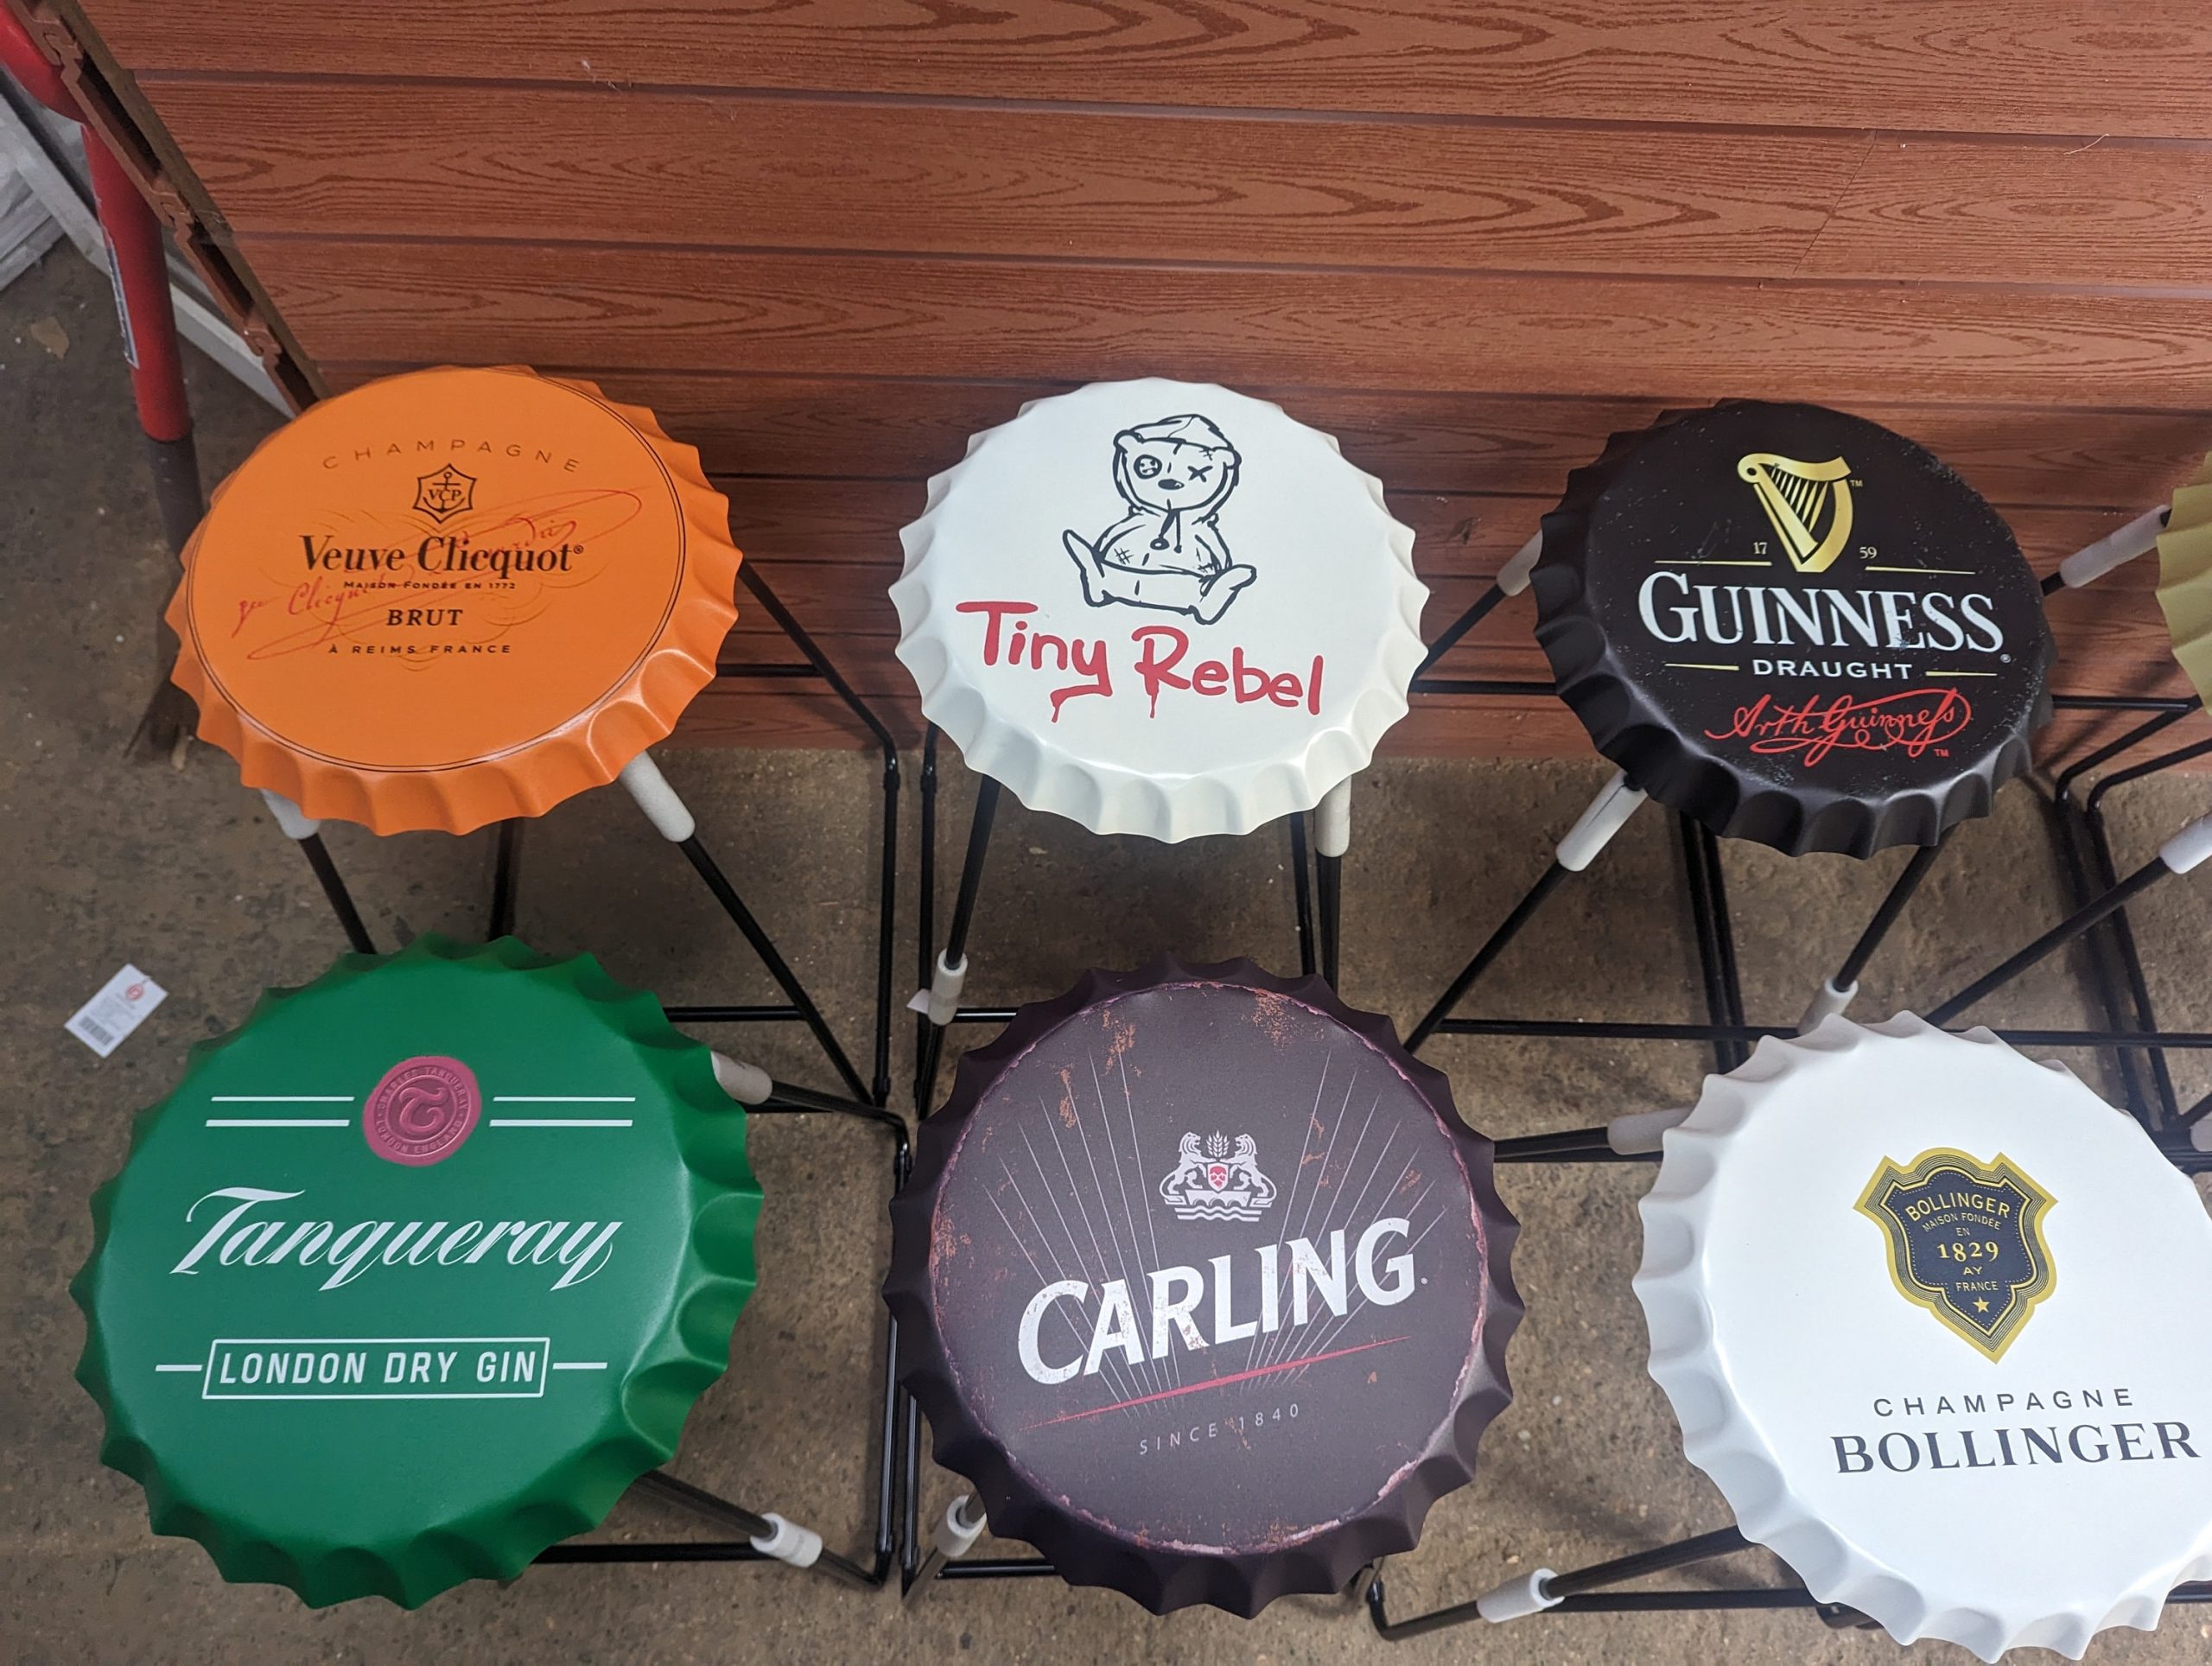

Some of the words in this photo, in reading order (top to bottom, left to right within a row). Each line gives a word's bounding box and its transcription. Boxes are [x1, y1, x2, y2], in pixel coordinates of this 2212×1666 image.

[322, 439, 580, 473] CHAMPAGNE
[428, 487, 462, 503] VCP
[299, 534, 405, 571] Veuve
[1753, 542, 1768, 555] 17
[1859, 546, 1878, 559] 59
[344, 581, 397, 589] MAISON
[386, 608, 464, 626] BRUT
[352, 645, 416, 654] REIMS
[429, 645, 511, 653] FRANCE
[956, 601, 1113, 722] Tiny
[1131, 626, 1324, 719] Rebel
[1752, 659, 1912, 680] DRAUGHT
[1904, 1192, 2011, 1222] BOLLINGER
[1922, 1212, 1959, 1232] MAISON
[1961, 1212, 2002, 1230] FONDÉE
[1955, 1227, 1971, 1237] EN
[170, 1186, 623, 1292] Tanqueray
[1936, 1241, 1999, 1262] 1829
[1962, 1266, 1983, 1275] AY
[1955, 1281, 1999, 1292] FRANCE
[1018, 1217, 1415, 1385] CARLING
[219, 1352, 367, 1384] LONDON
[384, 1351, 458, 1383] DRY
[476, 1351, 536, 1383] GIN
[1873, 1388, 2133, 1417] CHAMPAGNE
[1139, 1422, 1218, 1455] SINCE
[1238, 1403, 1299, 1431] 1840
[1831, 1421, 2201, 1473] BOLLINGER
